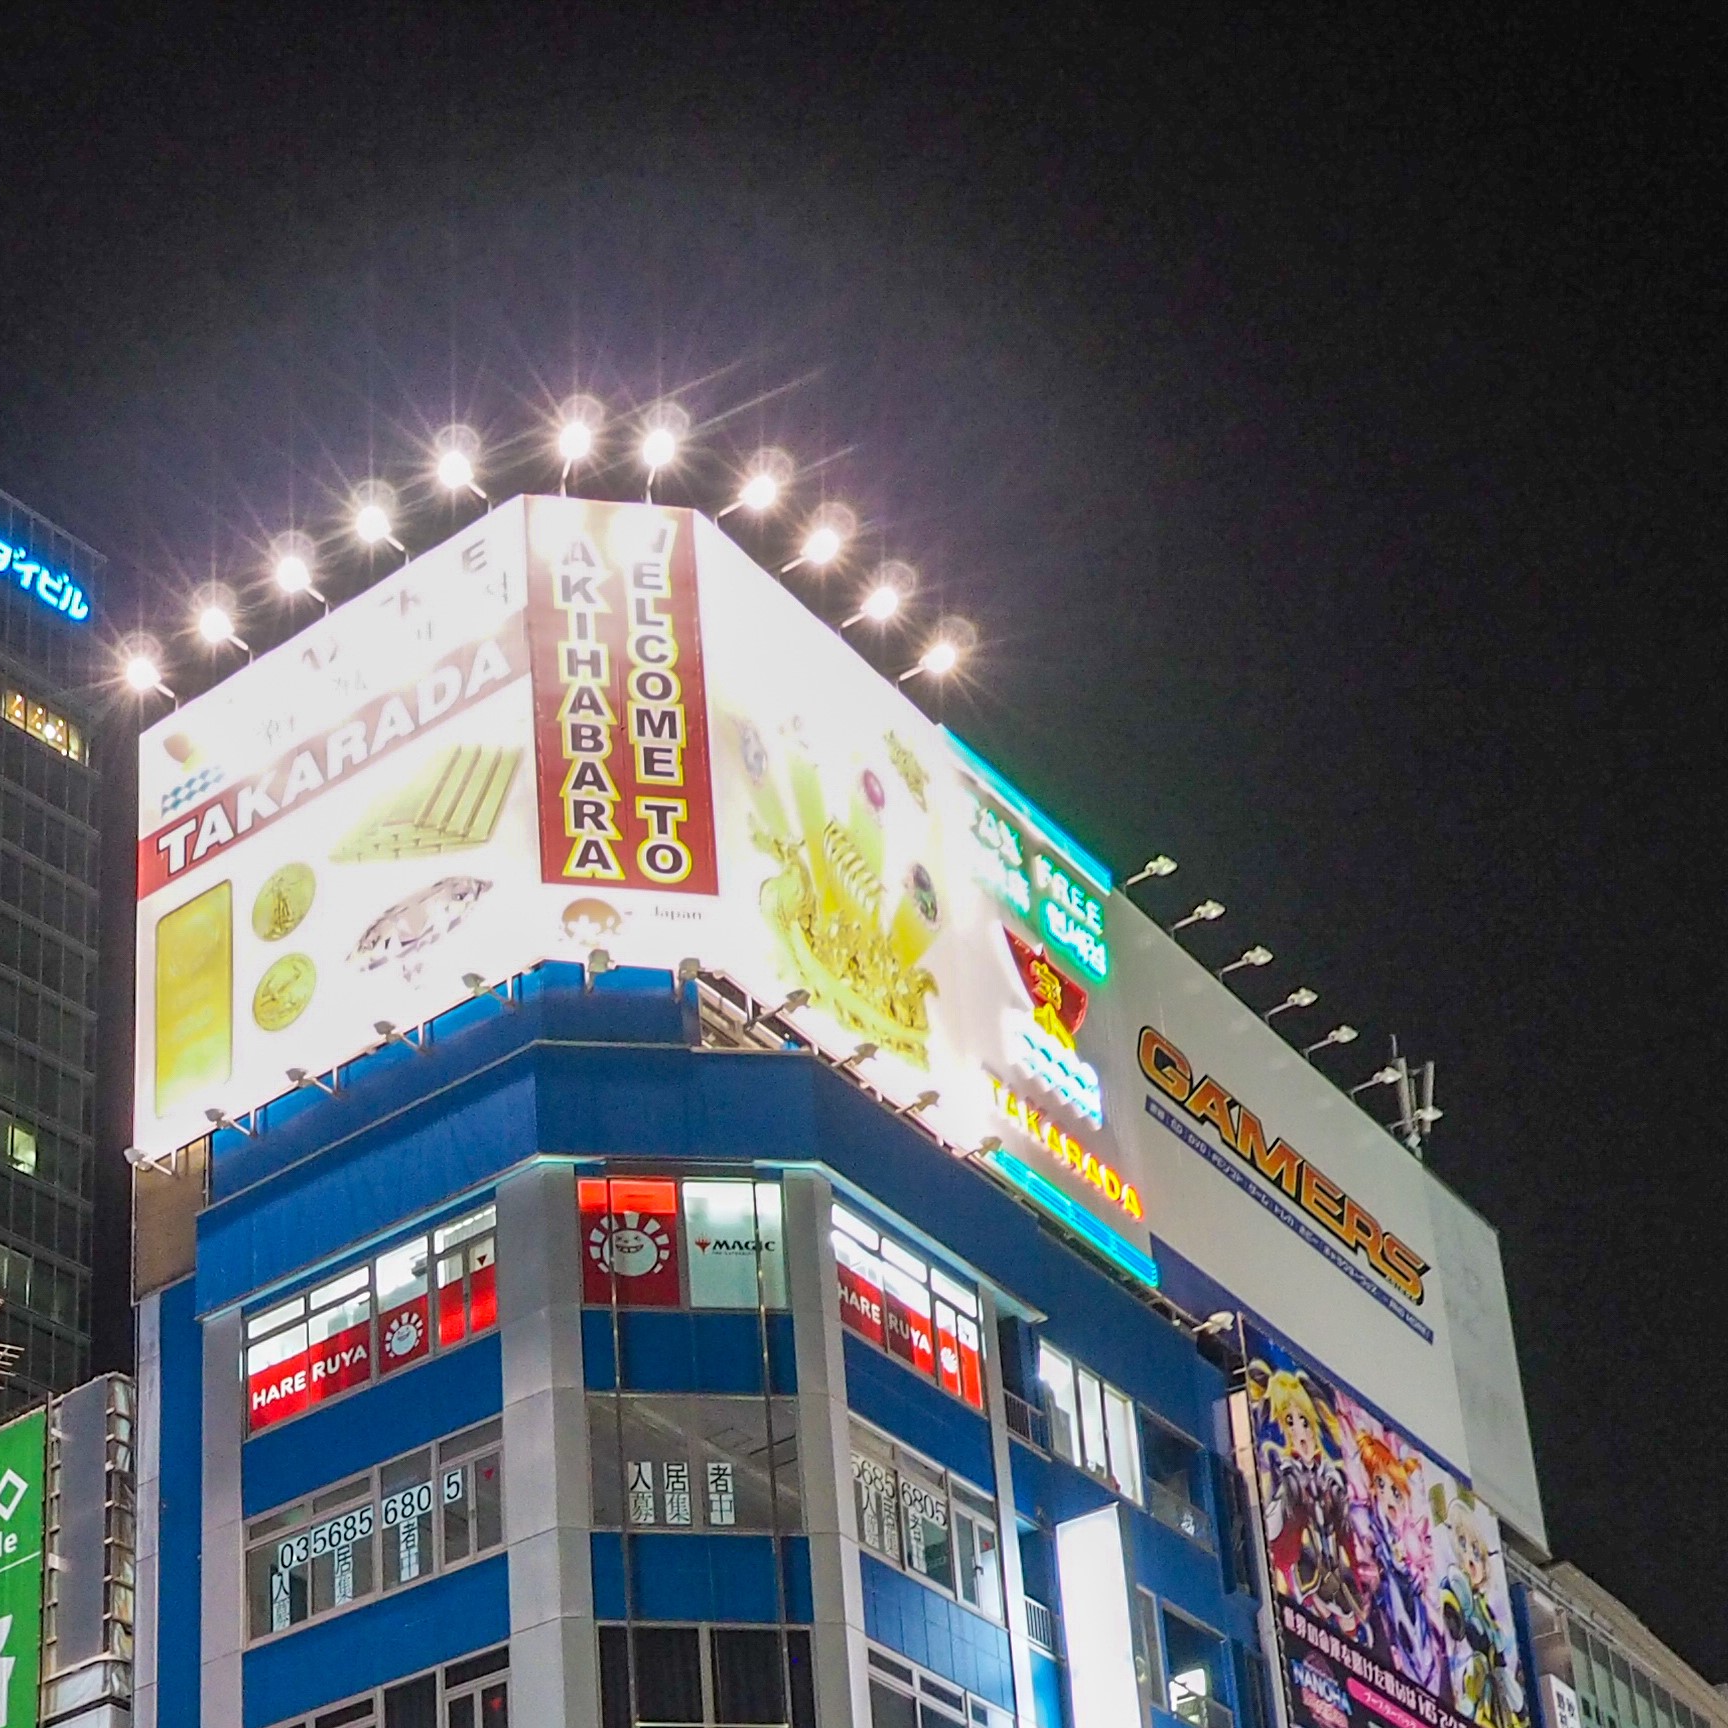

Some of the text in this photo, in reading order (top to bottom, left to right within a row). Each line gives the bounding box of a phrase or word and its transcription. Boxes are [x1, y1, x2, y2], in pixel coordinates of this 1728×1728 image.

[156, 636, 513, 880] TAKARADA
[559, 538, 628, 882] AKIHABARA
[627, 518, 694, 886] ELCOME TO
[1034, 853, 1105, 936] FREE
[985, 1073, 1144, 1223] TAKARADA
[1138, 1026, 1432, 1307] GAMERS
[712, 1238, 776, 1253] MAGC
[837, 1283, 933, 1357] HARE RUYA
[251, 1341, 368, 1411] HARE RUYA
